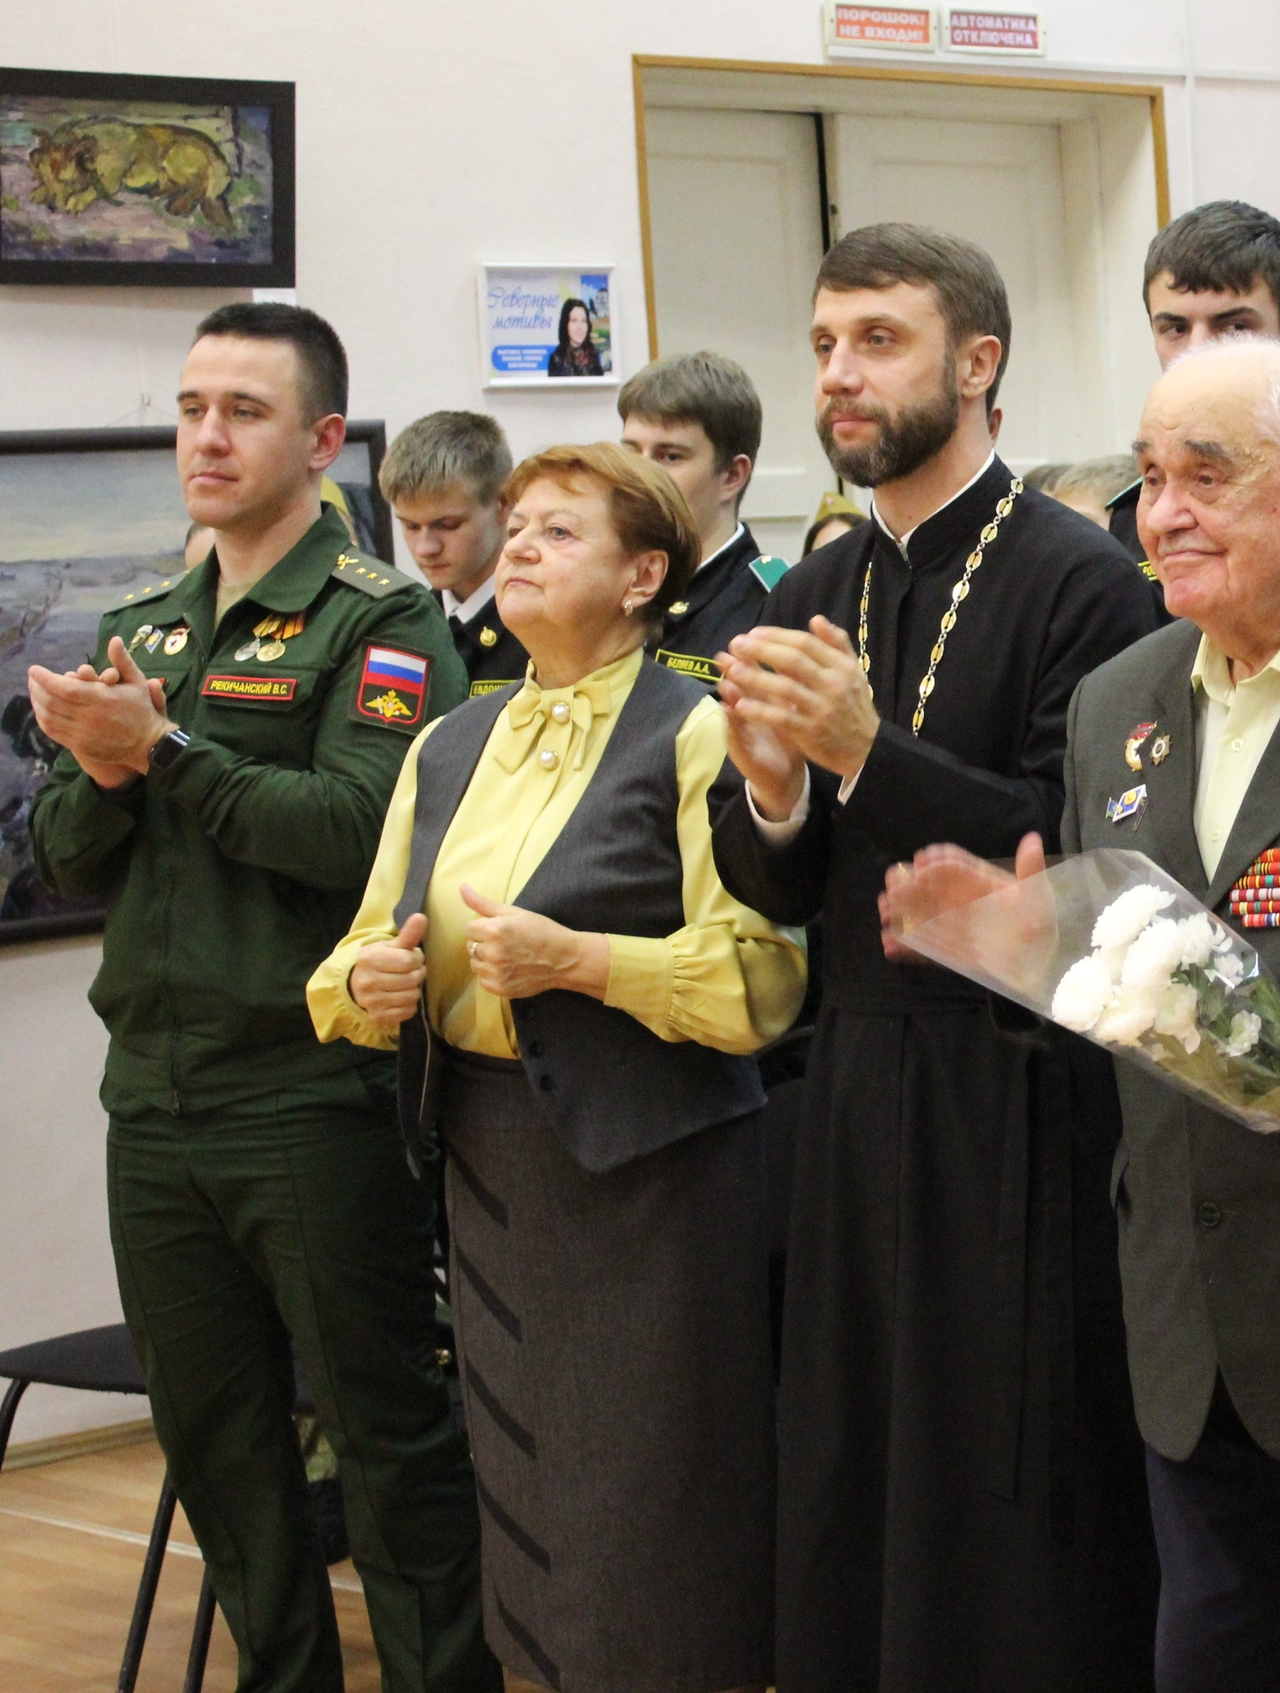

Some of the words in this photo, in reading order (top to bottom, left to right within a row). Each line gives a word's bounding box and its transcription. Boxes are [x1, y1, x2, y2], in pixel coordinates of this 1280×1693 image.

[837, 7, 925, 26] ПОРОШОК!
[952, 13, 1037, 31] АВТОМАТИКА
[839, 25, 860, 37] НЕ
[864, 26, 924, 42] ВХОДИ!
[953, 29, 1034, 46] ОТКЛЮЧЕНА
[210, 680, 272, 694] РЕКИЧАНСКИЙ
[272, 684, 288, 695] В.С.
